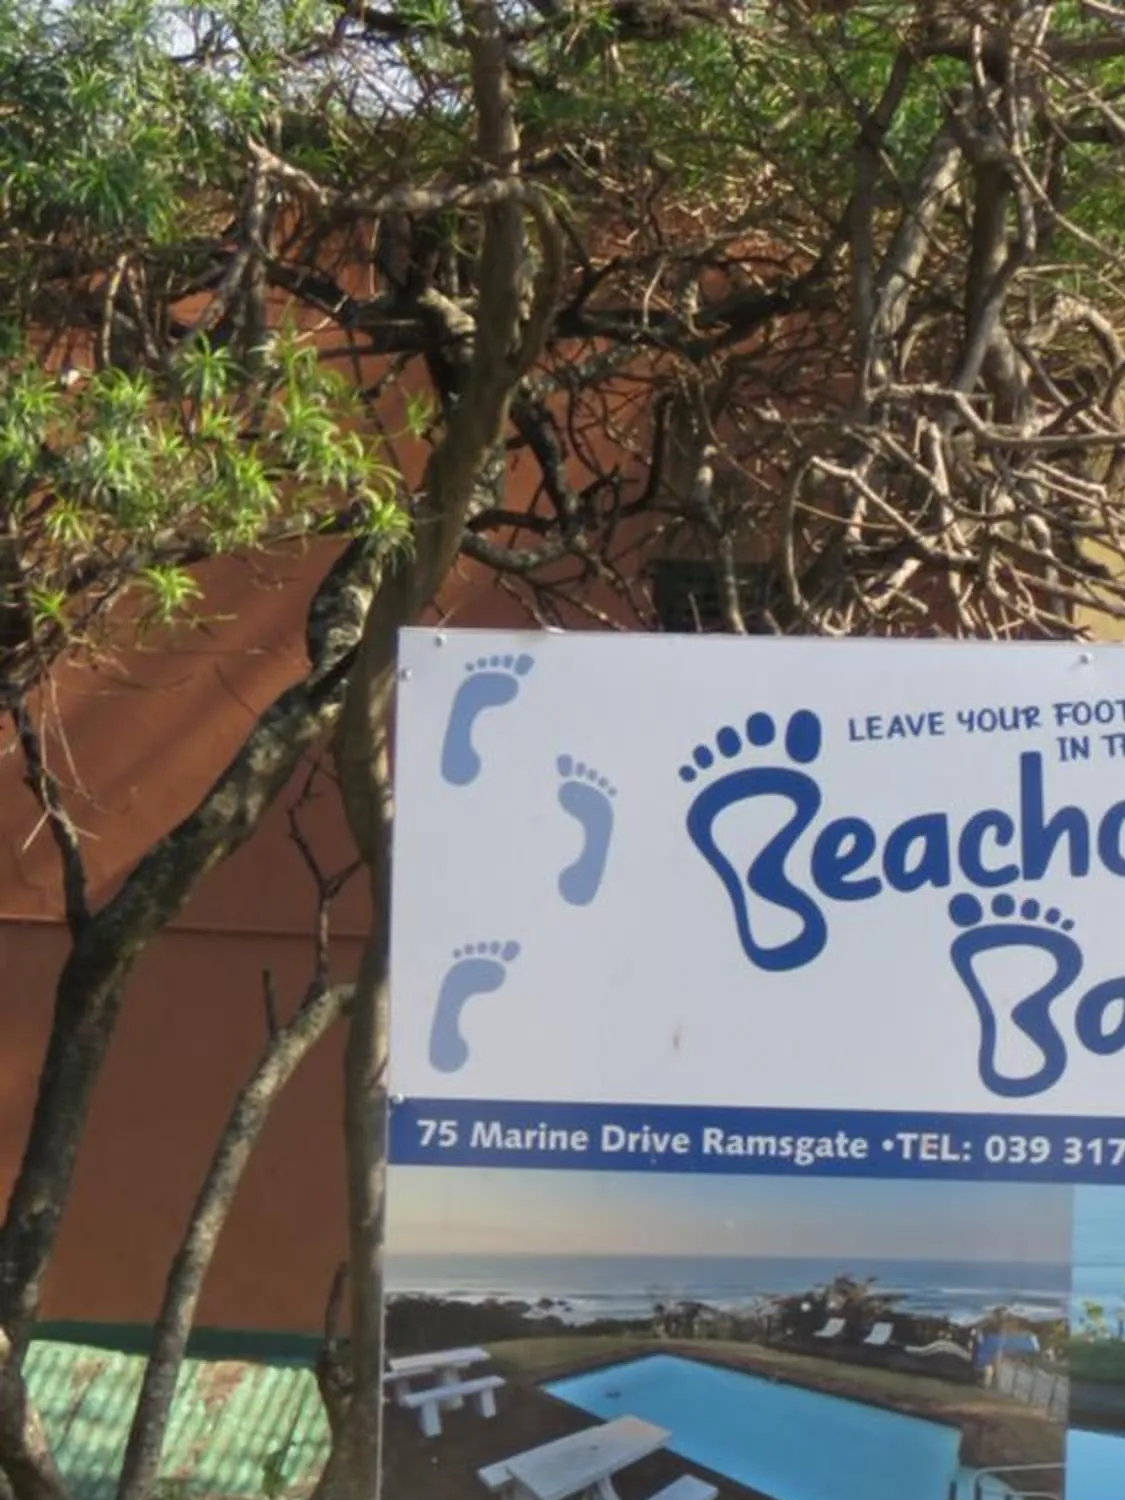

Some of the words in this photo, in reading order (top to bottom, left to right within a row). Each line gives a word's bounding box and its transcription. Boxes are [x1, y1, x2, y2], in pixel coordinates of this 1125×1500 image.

[848, 711, 945, 742] LEAVE
[957, 705, 1042, 734] YOUR
[1057, 736, 1090, 762] IN
[416, 1119, 459, 1148] 75
[469, 1120, 589, 1152] Marine
[600, 1123, 691, 1155] Drive
[701, 1127, 869, 1166] Ramsgate
[985, 1134, 1050, 1164] 039
